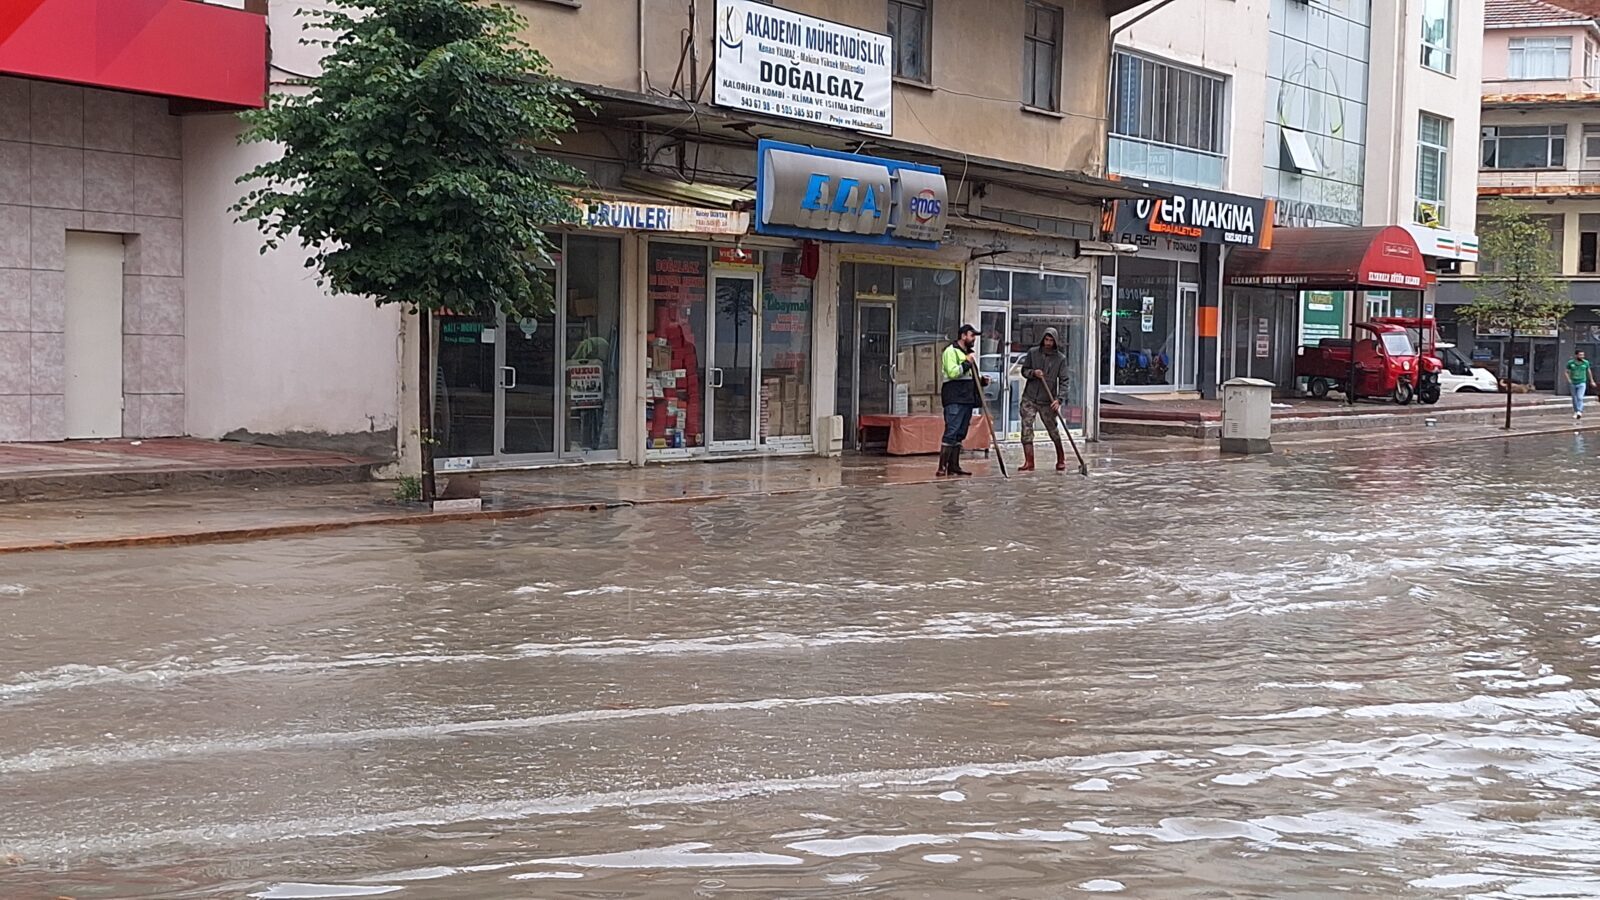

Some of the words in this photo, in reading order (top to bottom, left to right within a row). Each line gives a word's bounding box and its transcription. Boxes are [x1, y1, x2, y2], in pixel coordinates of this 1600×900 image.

[745, 12, 802, 47] AKADEMİ
[805, 23, 885, 66] MÜHENDİSLİK
[760, 60, 865, 102] DOĞALGAZ
[741, 96, 753, 107] 543
[762, 86, 785, 99] KOMBİ
[791, 93, 813, 105] KLİMA
[815, 98, 824, 107] VE
[910, 196, 942, 216] emas
[1121, 232, 1157, 247] FLASH
[1172, 241, 1197, 253] TORNADO
